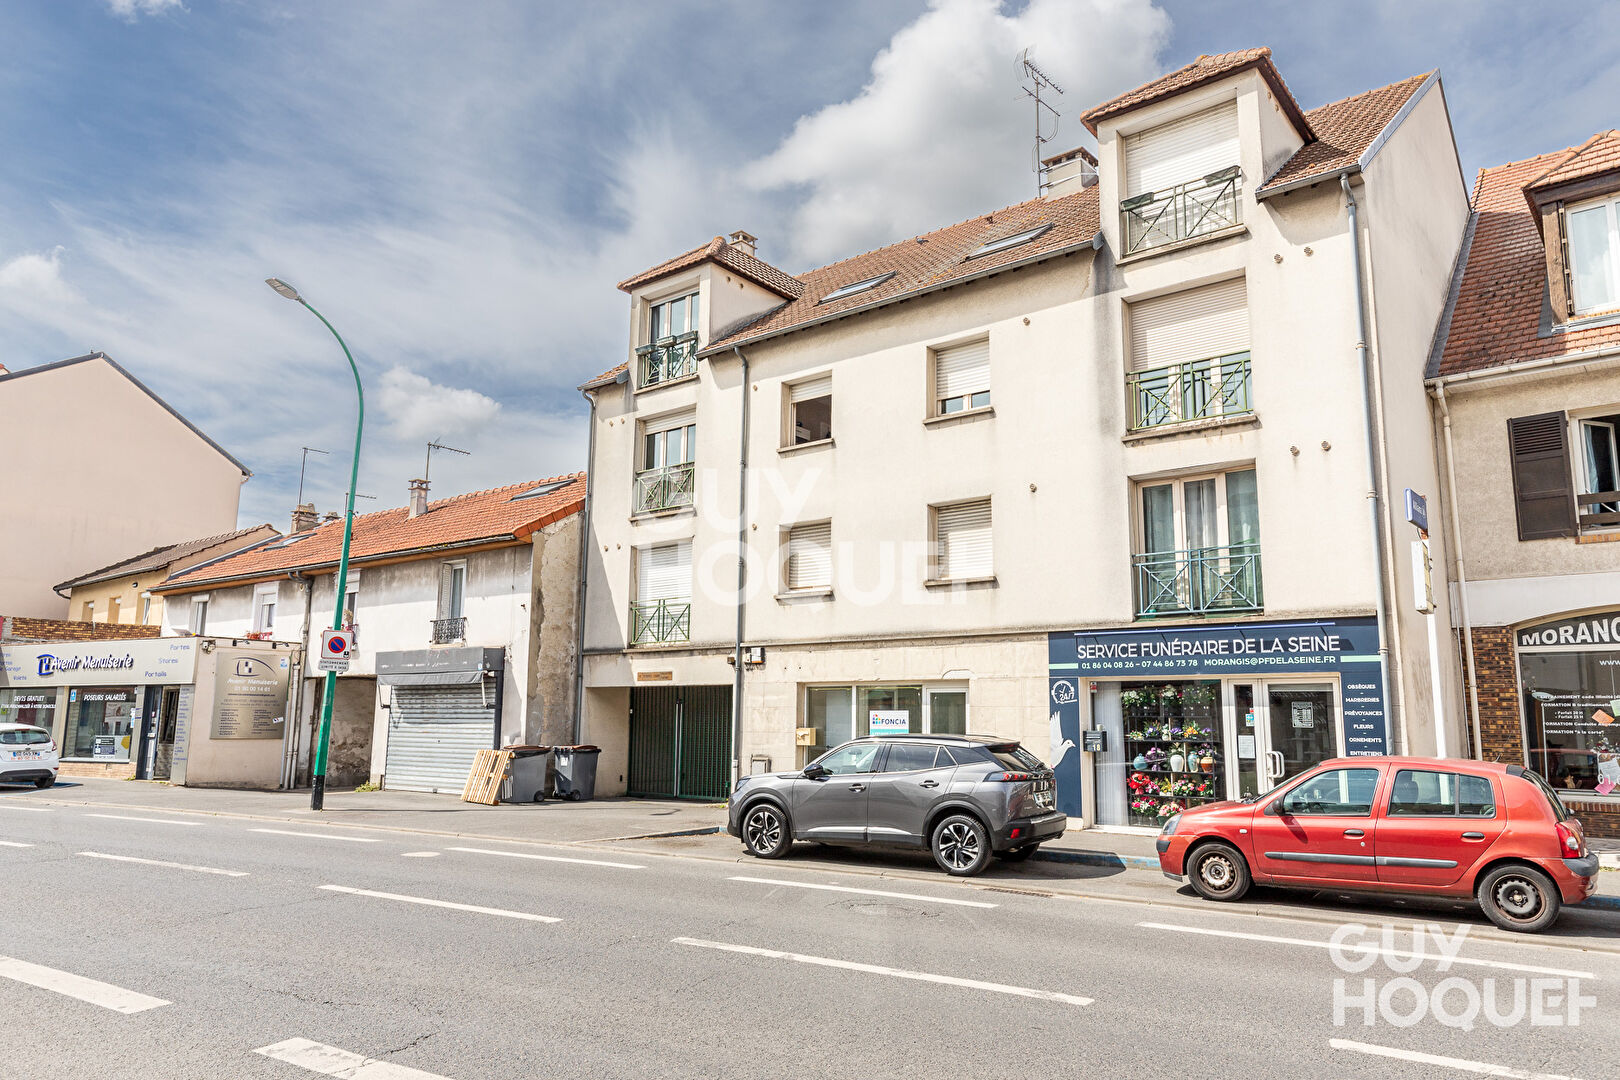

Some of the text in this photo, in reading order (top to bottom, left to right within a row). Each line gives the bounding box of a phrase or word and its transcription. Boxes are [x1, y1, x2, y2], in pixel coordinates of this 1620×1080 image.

[1077, 635, 1340, 659] SERVICE FUNÉRAIRE DE LA SEINE
[51, 653, 134, 671] Avenir Menuiserie
[1204, 656, 1336, 666] MORANGIS@PFDELASEINE.FR
[1092, 743, 1101, 751] 18
